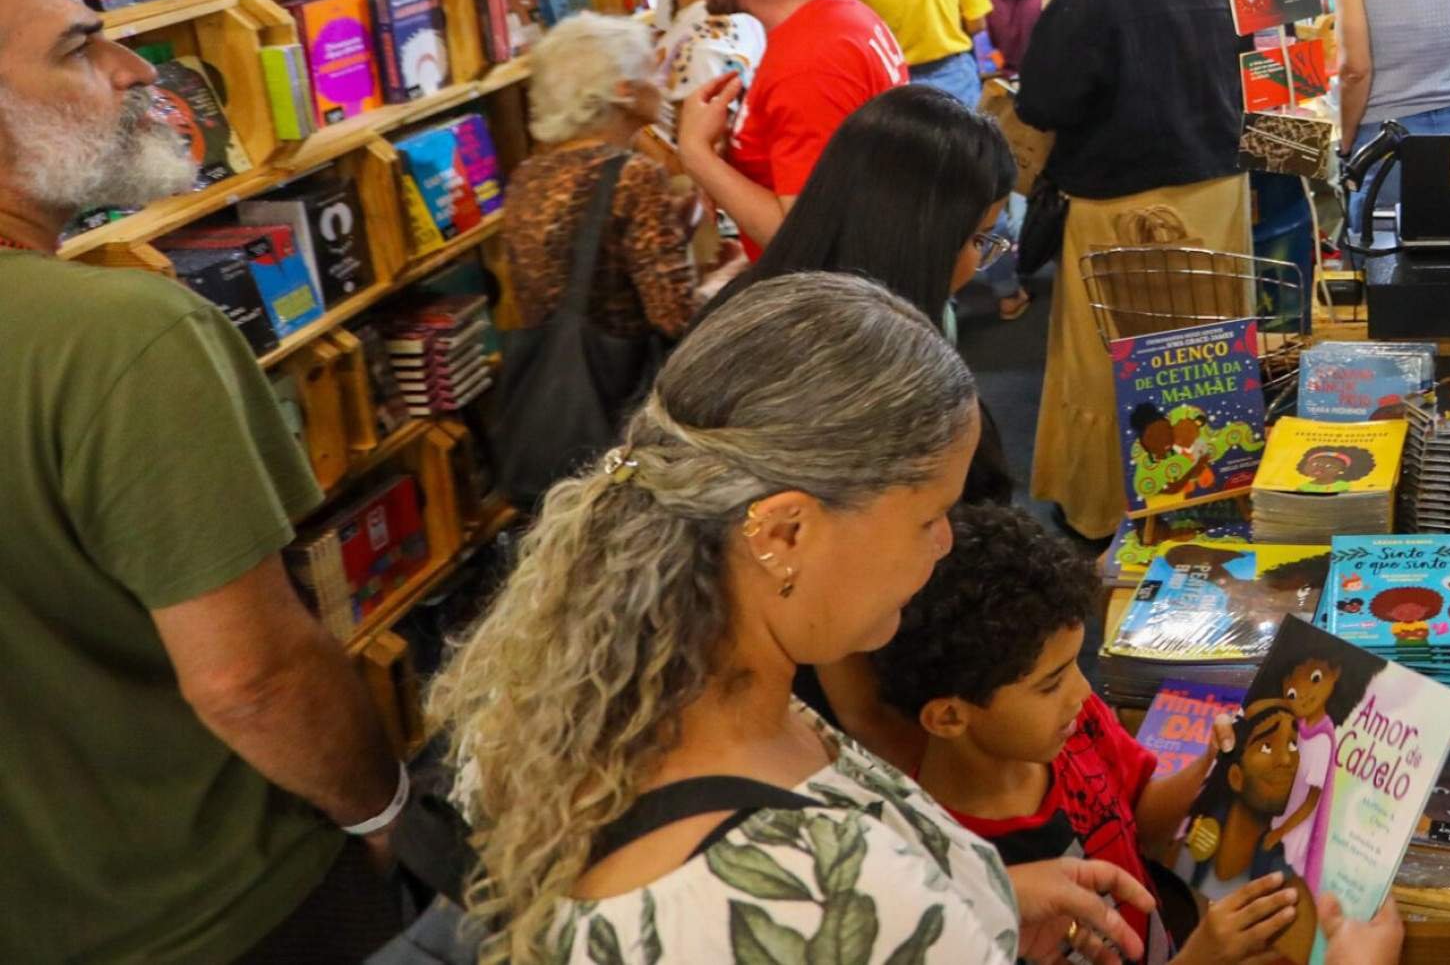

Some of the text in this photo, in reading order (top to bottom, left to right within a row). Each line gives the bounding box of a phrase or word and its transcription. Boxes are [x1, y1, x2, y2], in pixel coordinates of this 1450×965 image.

[1151, 355, 1162, 369] O
[1164, 341, 1229, 366] LENÇO
[1135, 360, 1242, 391] DE CETIM DA
[1161, 376, 1238, 403] MAMÃE
[1354, 557, 1449, 576] o que sinto
[1378, 547, 1425, 560] Sinto
[1352, 693, 1419, 750] Amor
[1405, 744, 1423, 770] de
[1334, 730, 1411, 801] Cabelo
